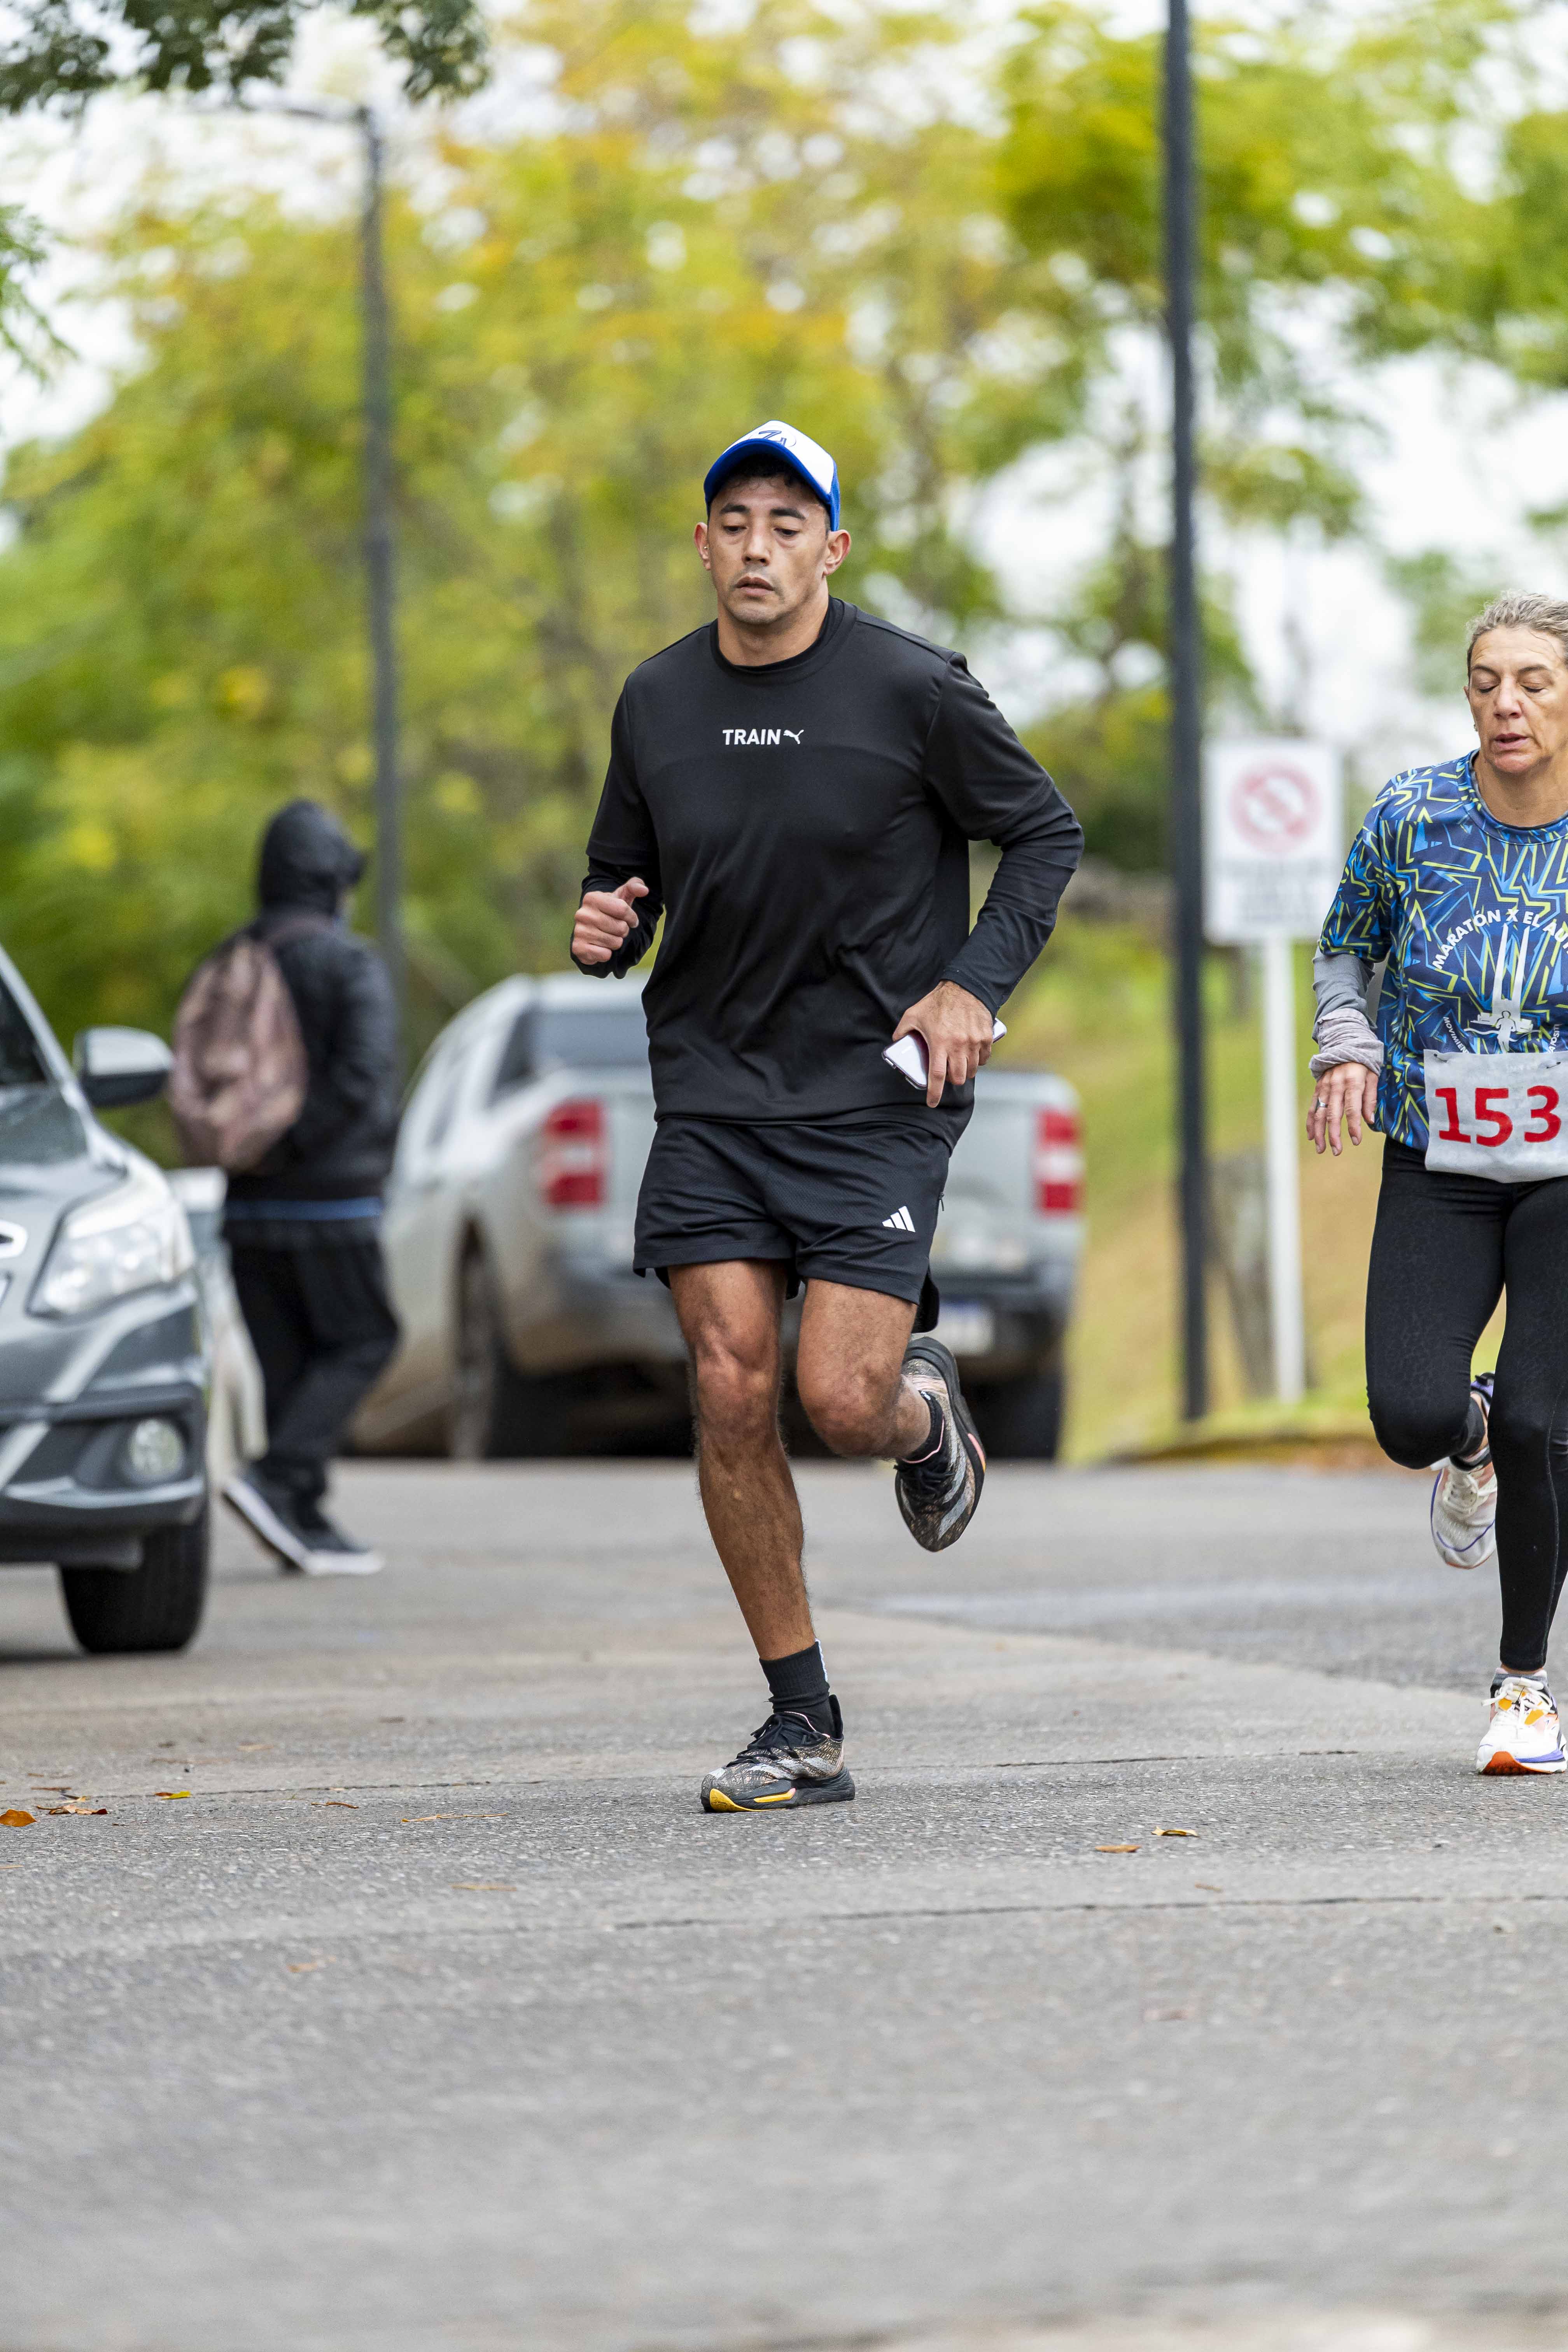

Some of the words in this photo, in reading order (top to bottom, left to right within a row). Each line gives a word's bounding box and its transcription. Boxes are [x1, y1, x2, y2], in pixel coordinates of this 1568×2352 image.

[723, 729, 781, 745] TRAIN
[1432, 909, 1501, 970] MARATÓN
[1505, 908, 1519, 922] X
[1522, 911, 1540, 928] EL
[1435, 1085, 1561, 1147] 153
